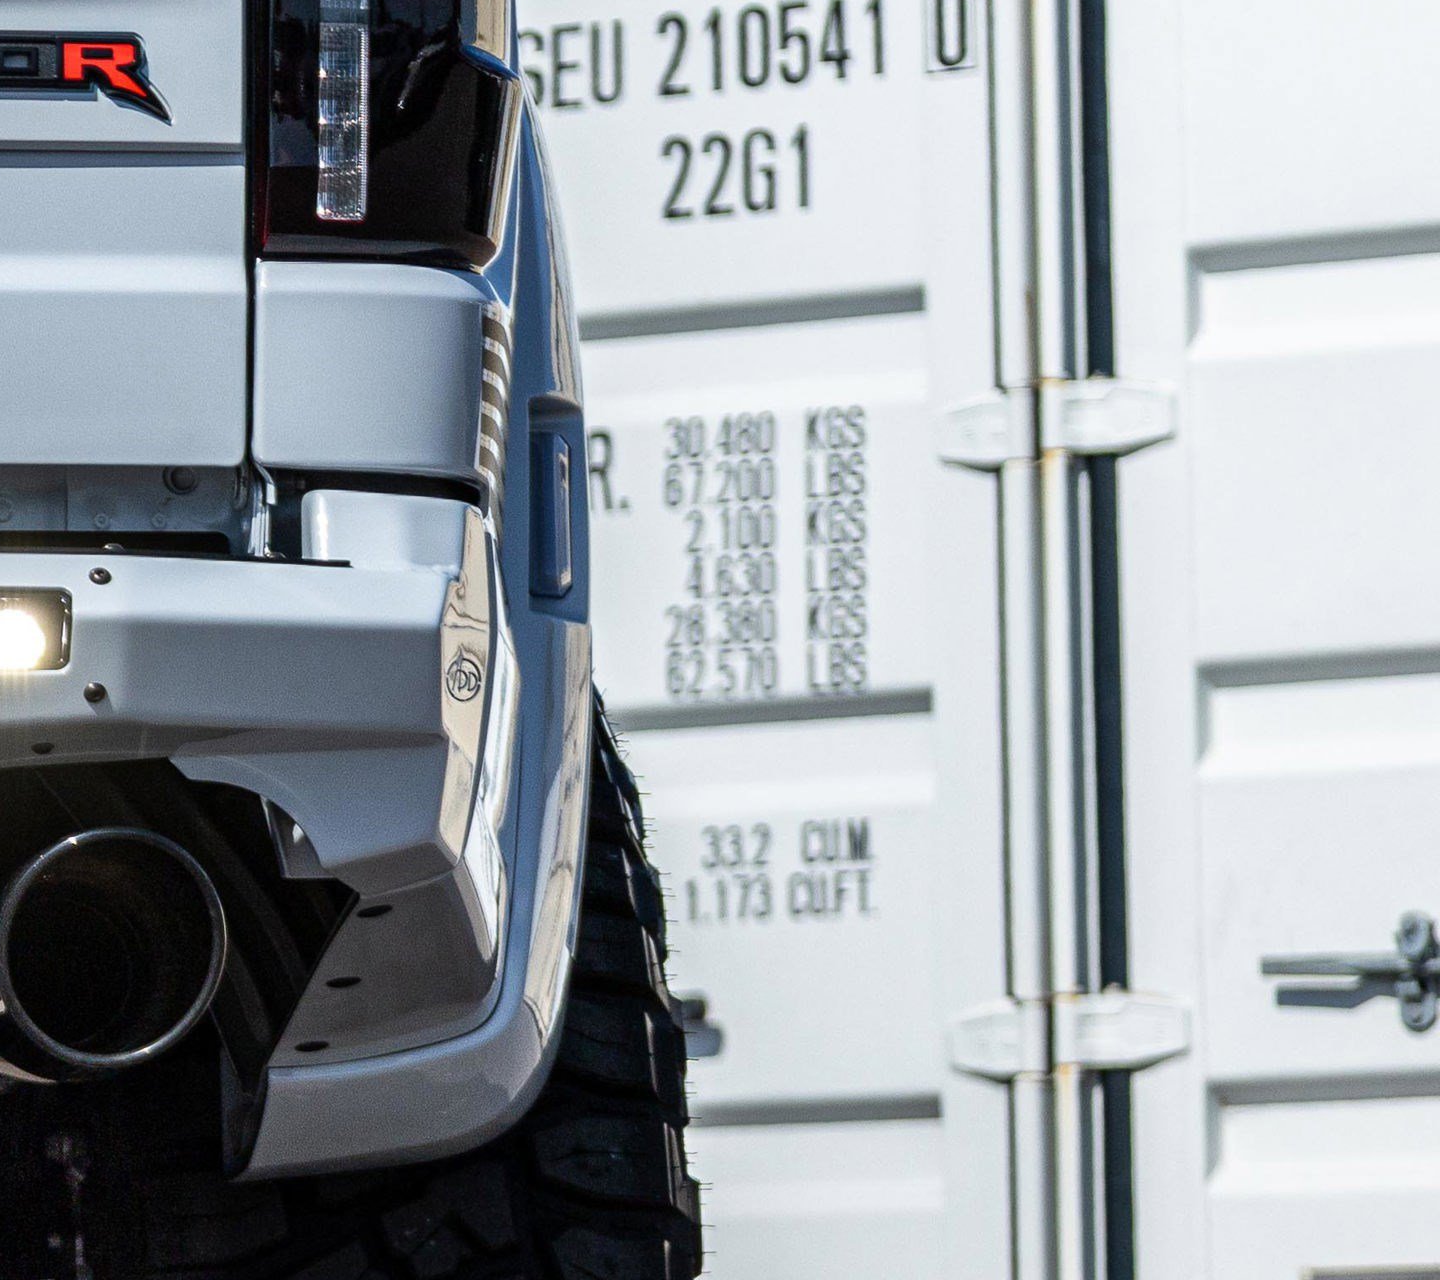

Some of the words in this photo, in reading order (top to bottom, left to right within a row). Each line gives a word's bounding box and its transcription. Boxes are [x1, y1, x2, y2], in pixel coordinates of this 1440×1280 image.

[661, 122, 810, 219] 22G1
[805, 405, 867, 450] KGS
[805, 451, 867, 497] LBS
[805, 498, 867, 545] KGS
[805, 545, 867, 592] LBS
[806, 593, 868, 640] KGS
[806, 640, 868, 687] LBS
